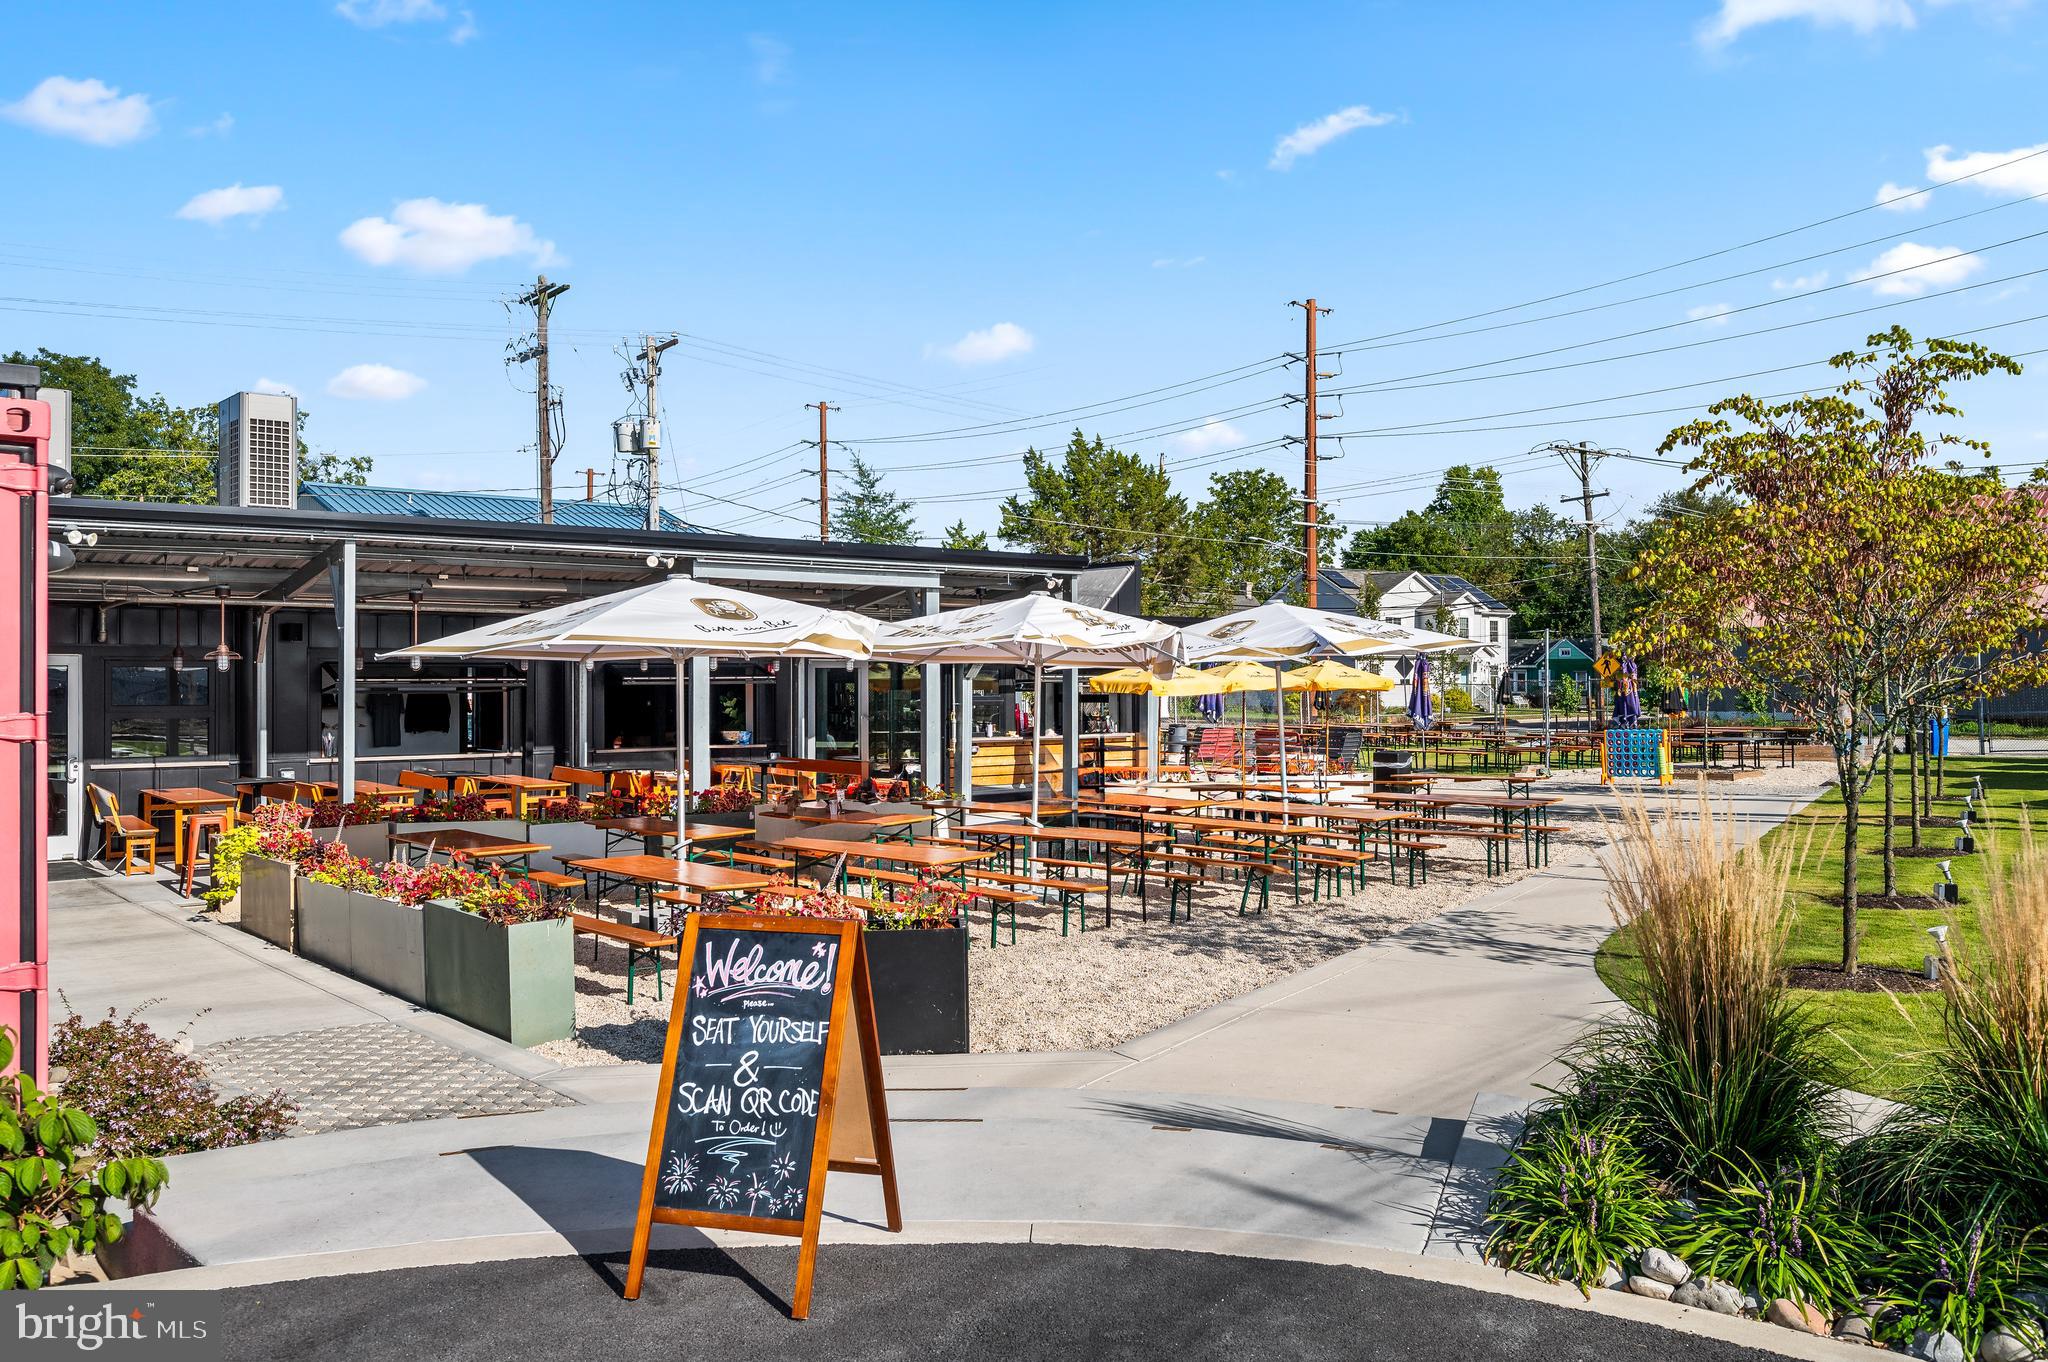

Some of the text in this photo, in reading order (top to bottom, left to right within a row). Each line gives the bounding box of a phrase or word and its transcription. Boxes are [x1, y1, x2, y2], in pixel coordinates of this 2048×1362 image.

[705, 937, 838, 995] Welcome!
[691, 1014, 831, 1047] SEAT YOURSELF
[733, 1050, 762, 1088] &
[677, 1081, 821, 1120] SCAN QR CODE
[711, 1118, 767, 1137] To Order!
